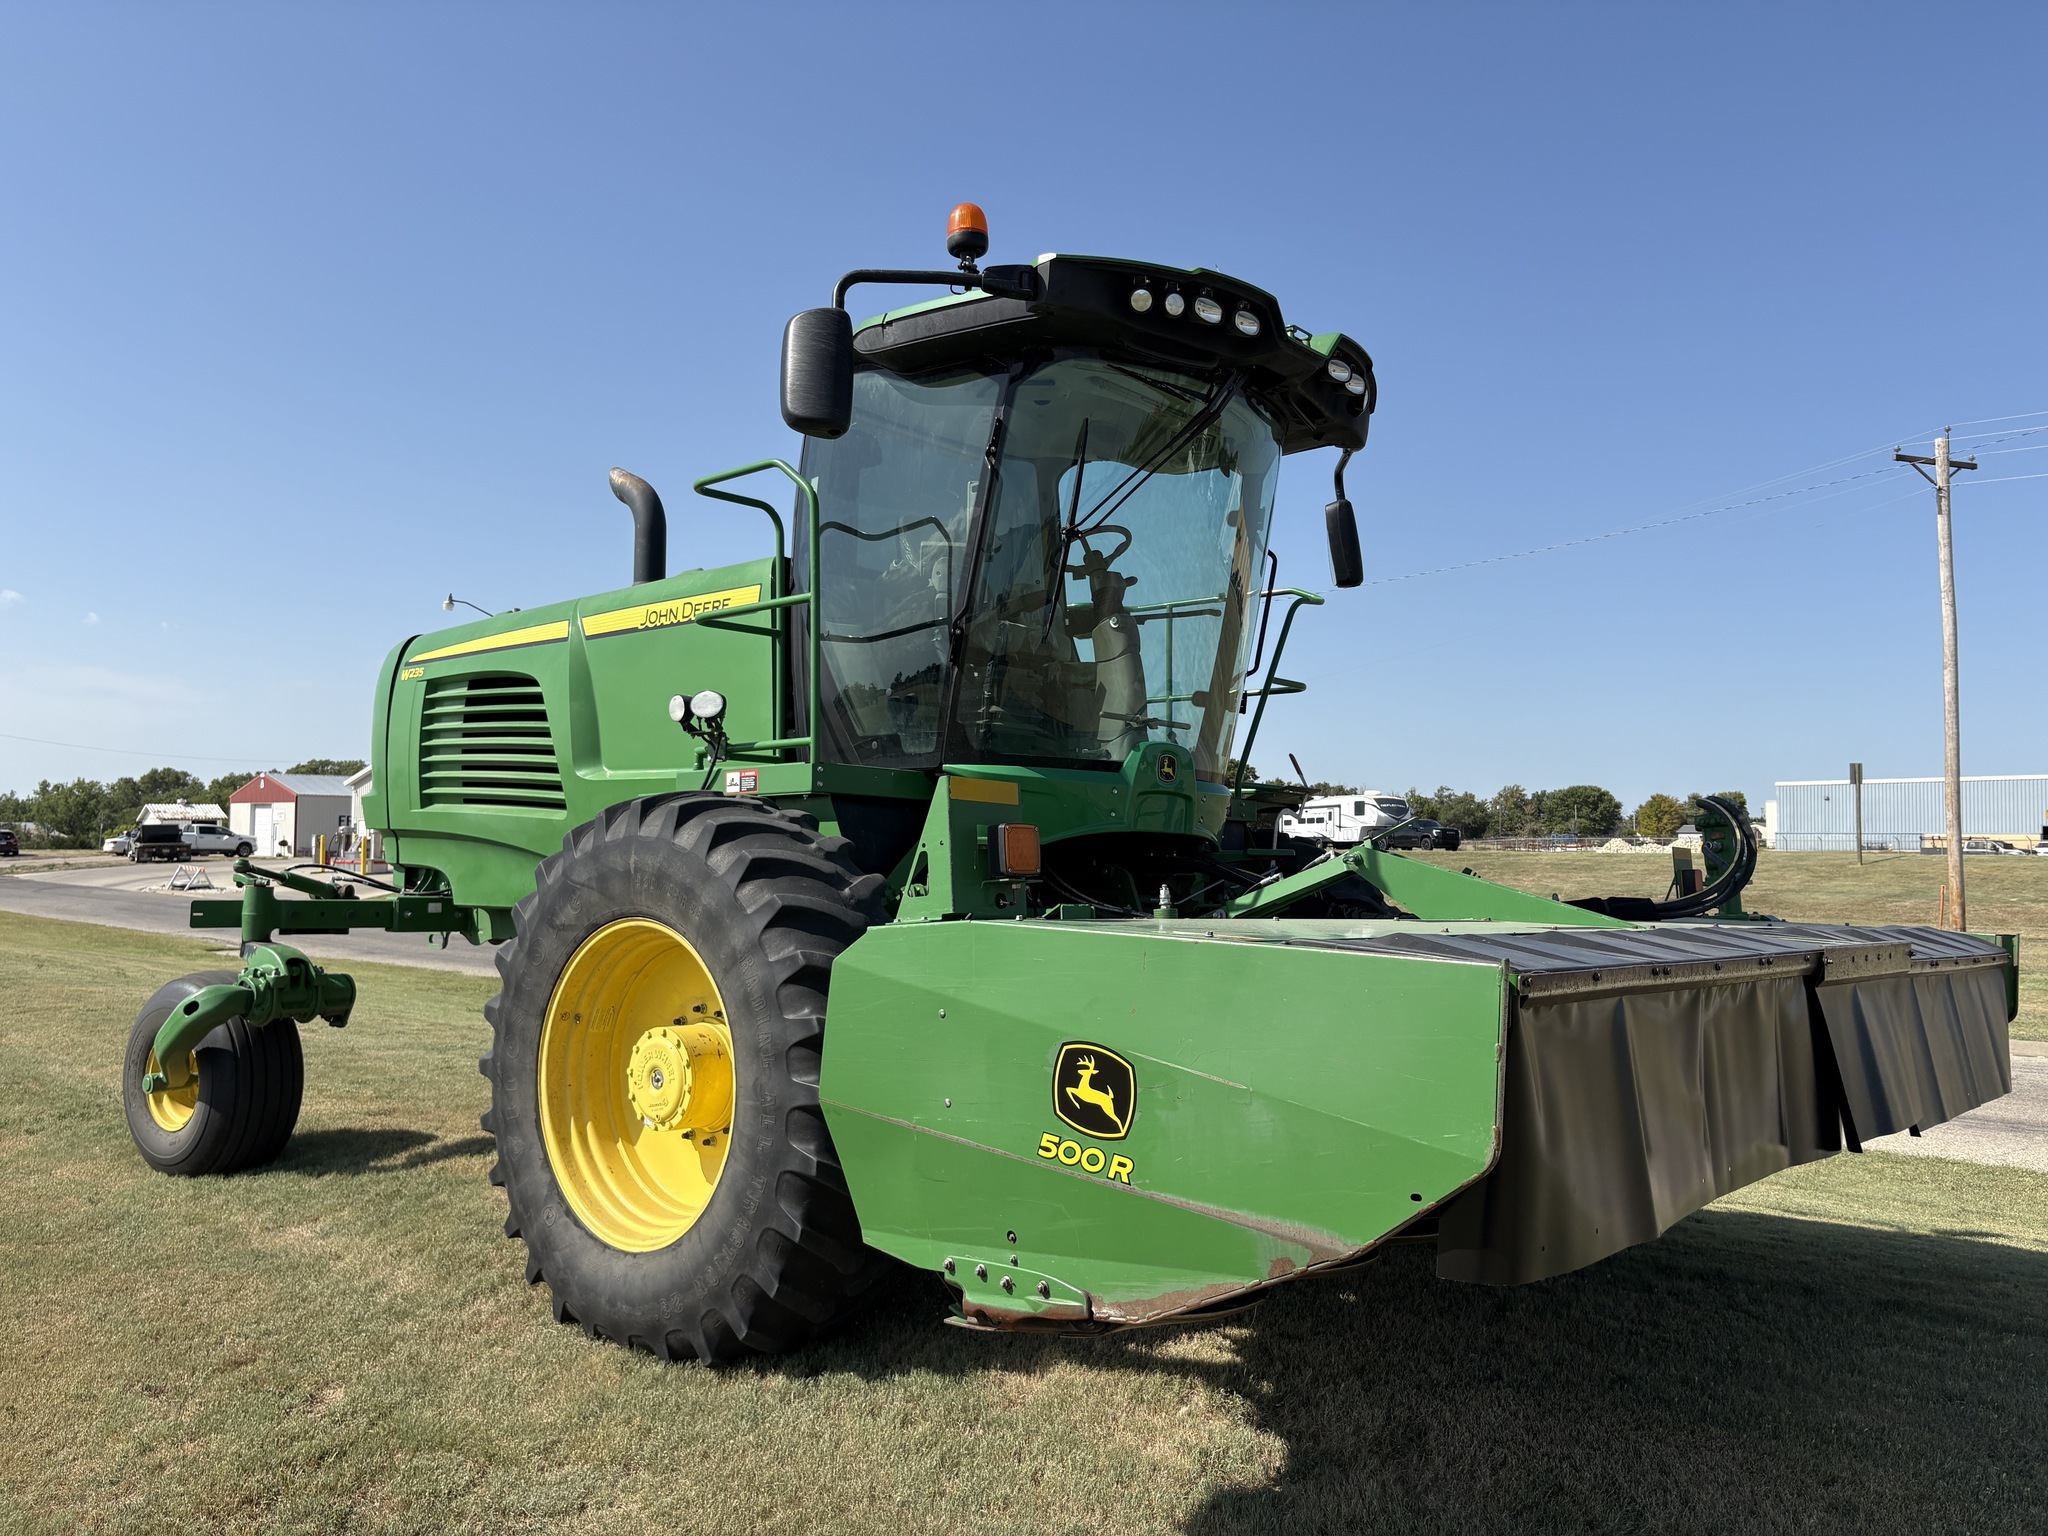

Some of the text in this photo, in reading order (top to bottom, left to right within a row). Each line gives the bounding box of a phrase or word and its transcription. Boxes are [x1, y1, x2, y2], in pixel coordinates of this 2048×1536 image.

[640, 597, 732, 627] JOHN DEERE
[401, 667, 425, 681] W235
[739, 952, 776, 1069] RADIAL
[756, 1092, 777, 1152] ALL
